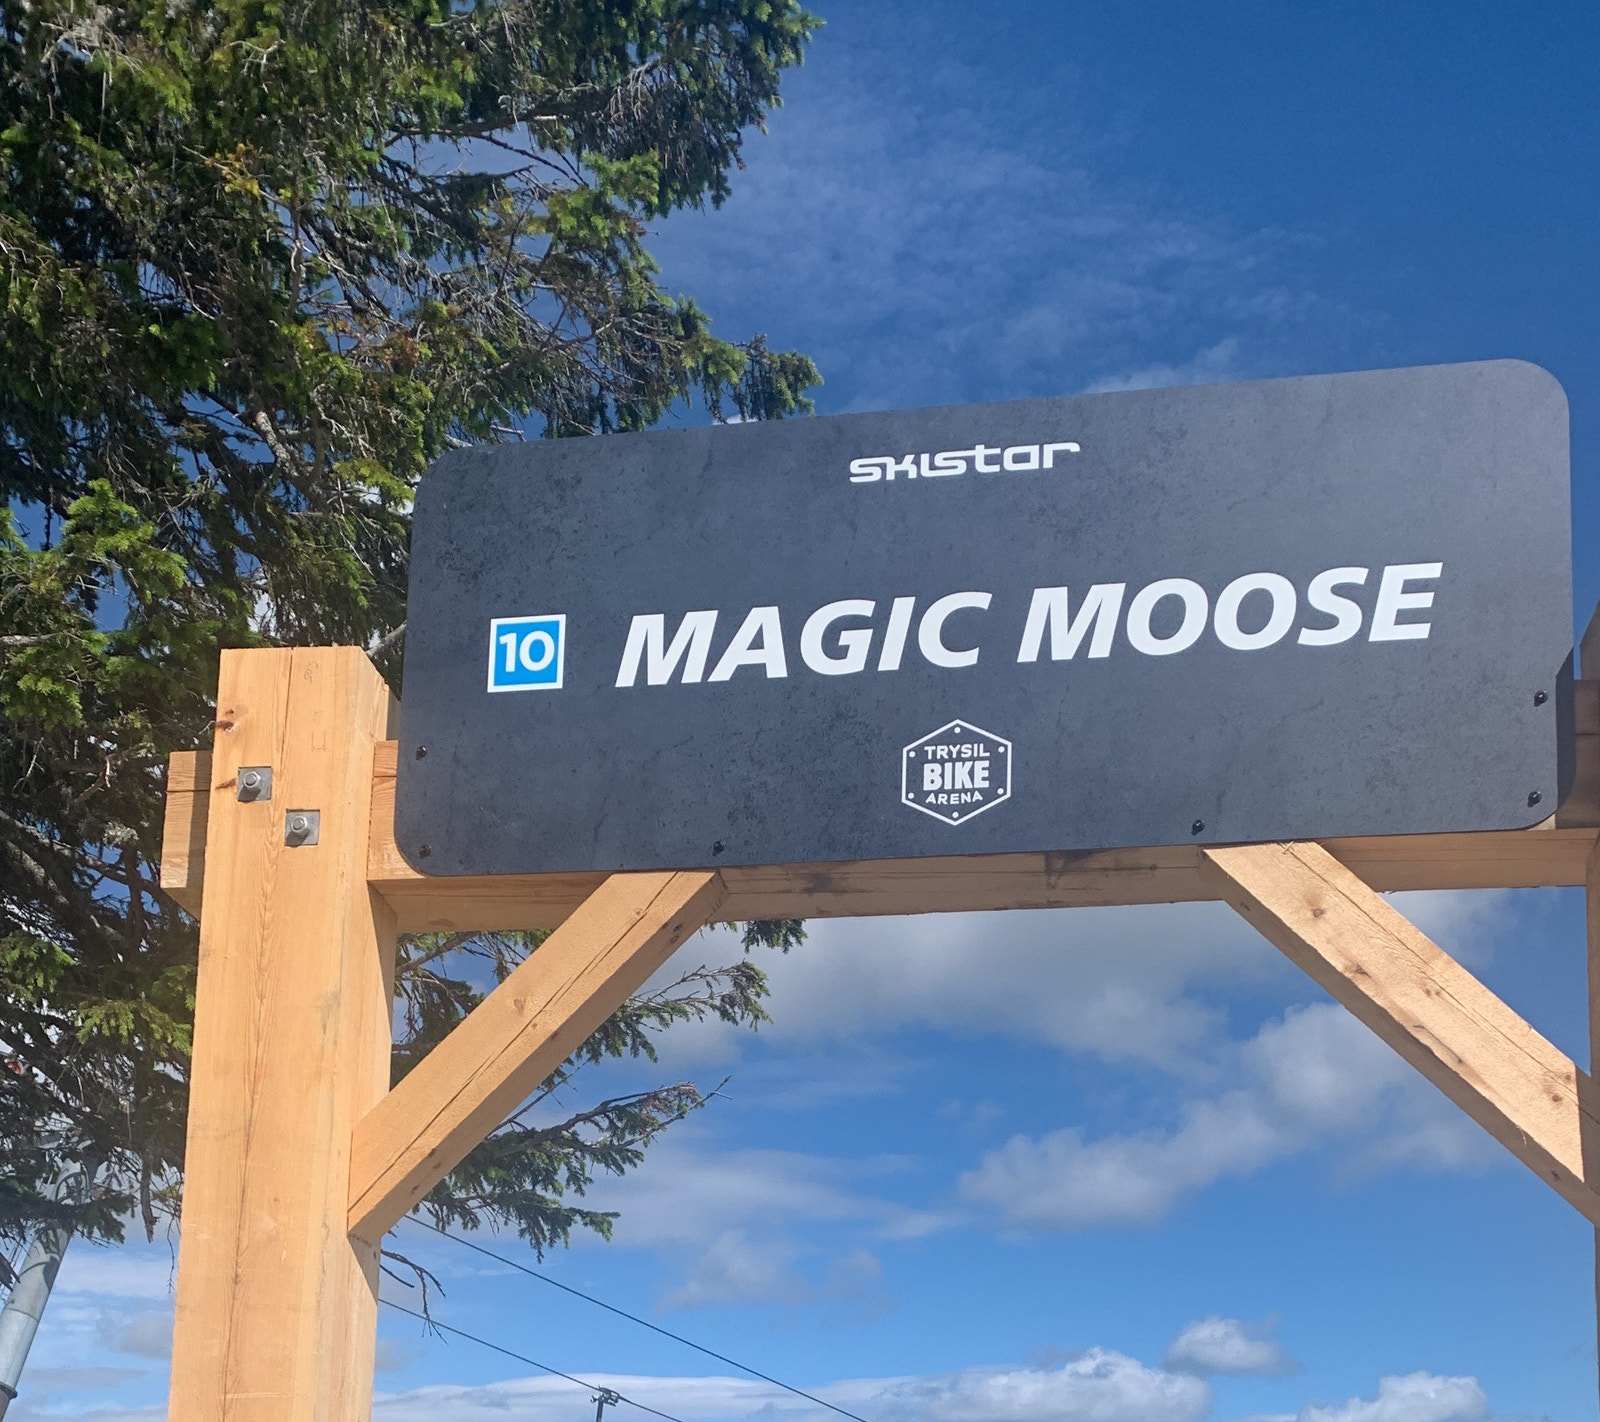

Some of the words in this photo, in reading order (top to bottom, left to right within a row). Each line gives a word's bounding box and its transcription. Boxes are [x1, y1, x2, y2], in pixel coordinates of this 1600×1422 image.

[498, 630, 555, 673] 10
[614, 591, 994, 688] MAGIC
[1016, 561, 1444, 664] MOOSE
[923, 743, 991, 760] TRYSIL
[922, 760, 990, 791] BIKE
[925, 790, 984, 805] ARENA
